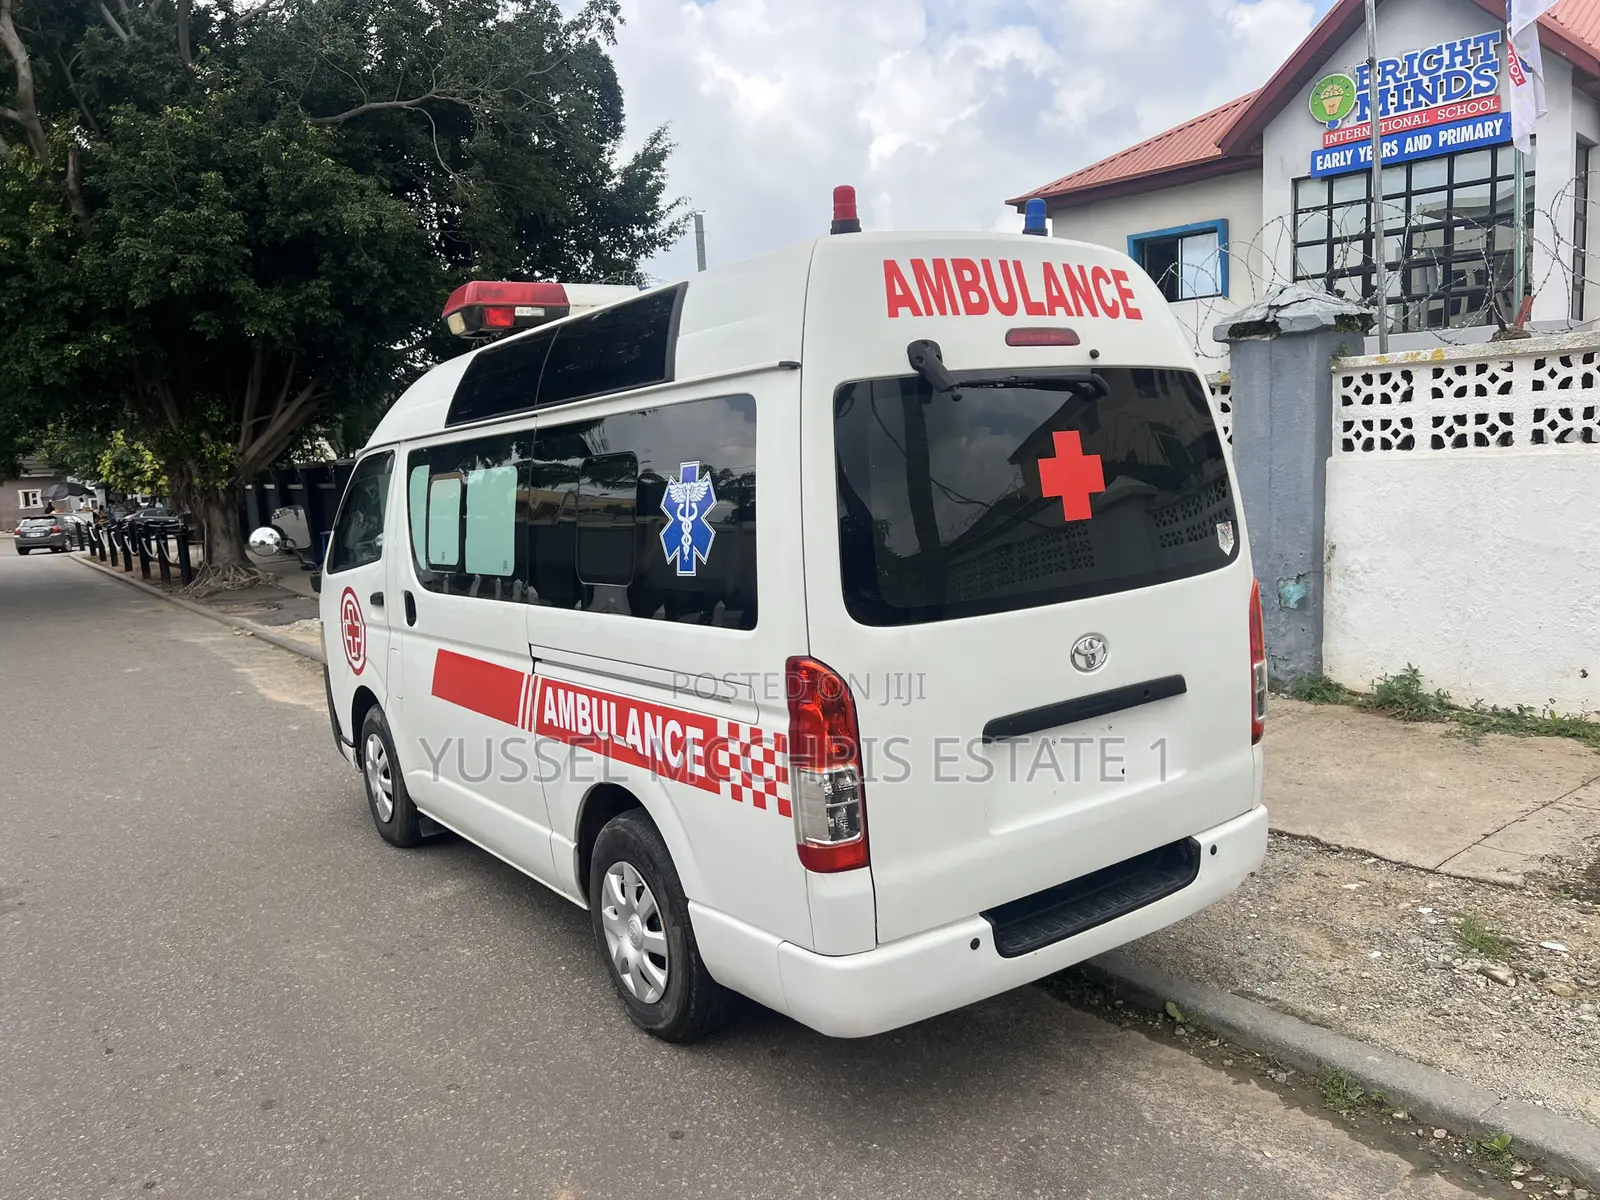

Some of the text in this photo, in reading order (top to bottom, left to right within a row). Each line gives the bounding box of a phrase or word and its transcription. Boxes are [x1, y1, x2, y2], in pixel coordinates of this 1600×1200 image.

[1356, 60, 1499, 121] MINDS
[1316, 118, 1503, 171] EARLY YERS AND PRIMARY
[1324, 98, 1498, 145] INTERNTIONAL SCHOOL
[882, 257, 1143, 321] AMBULANCE
[543, 686, 706, 778] AMBULANCE
